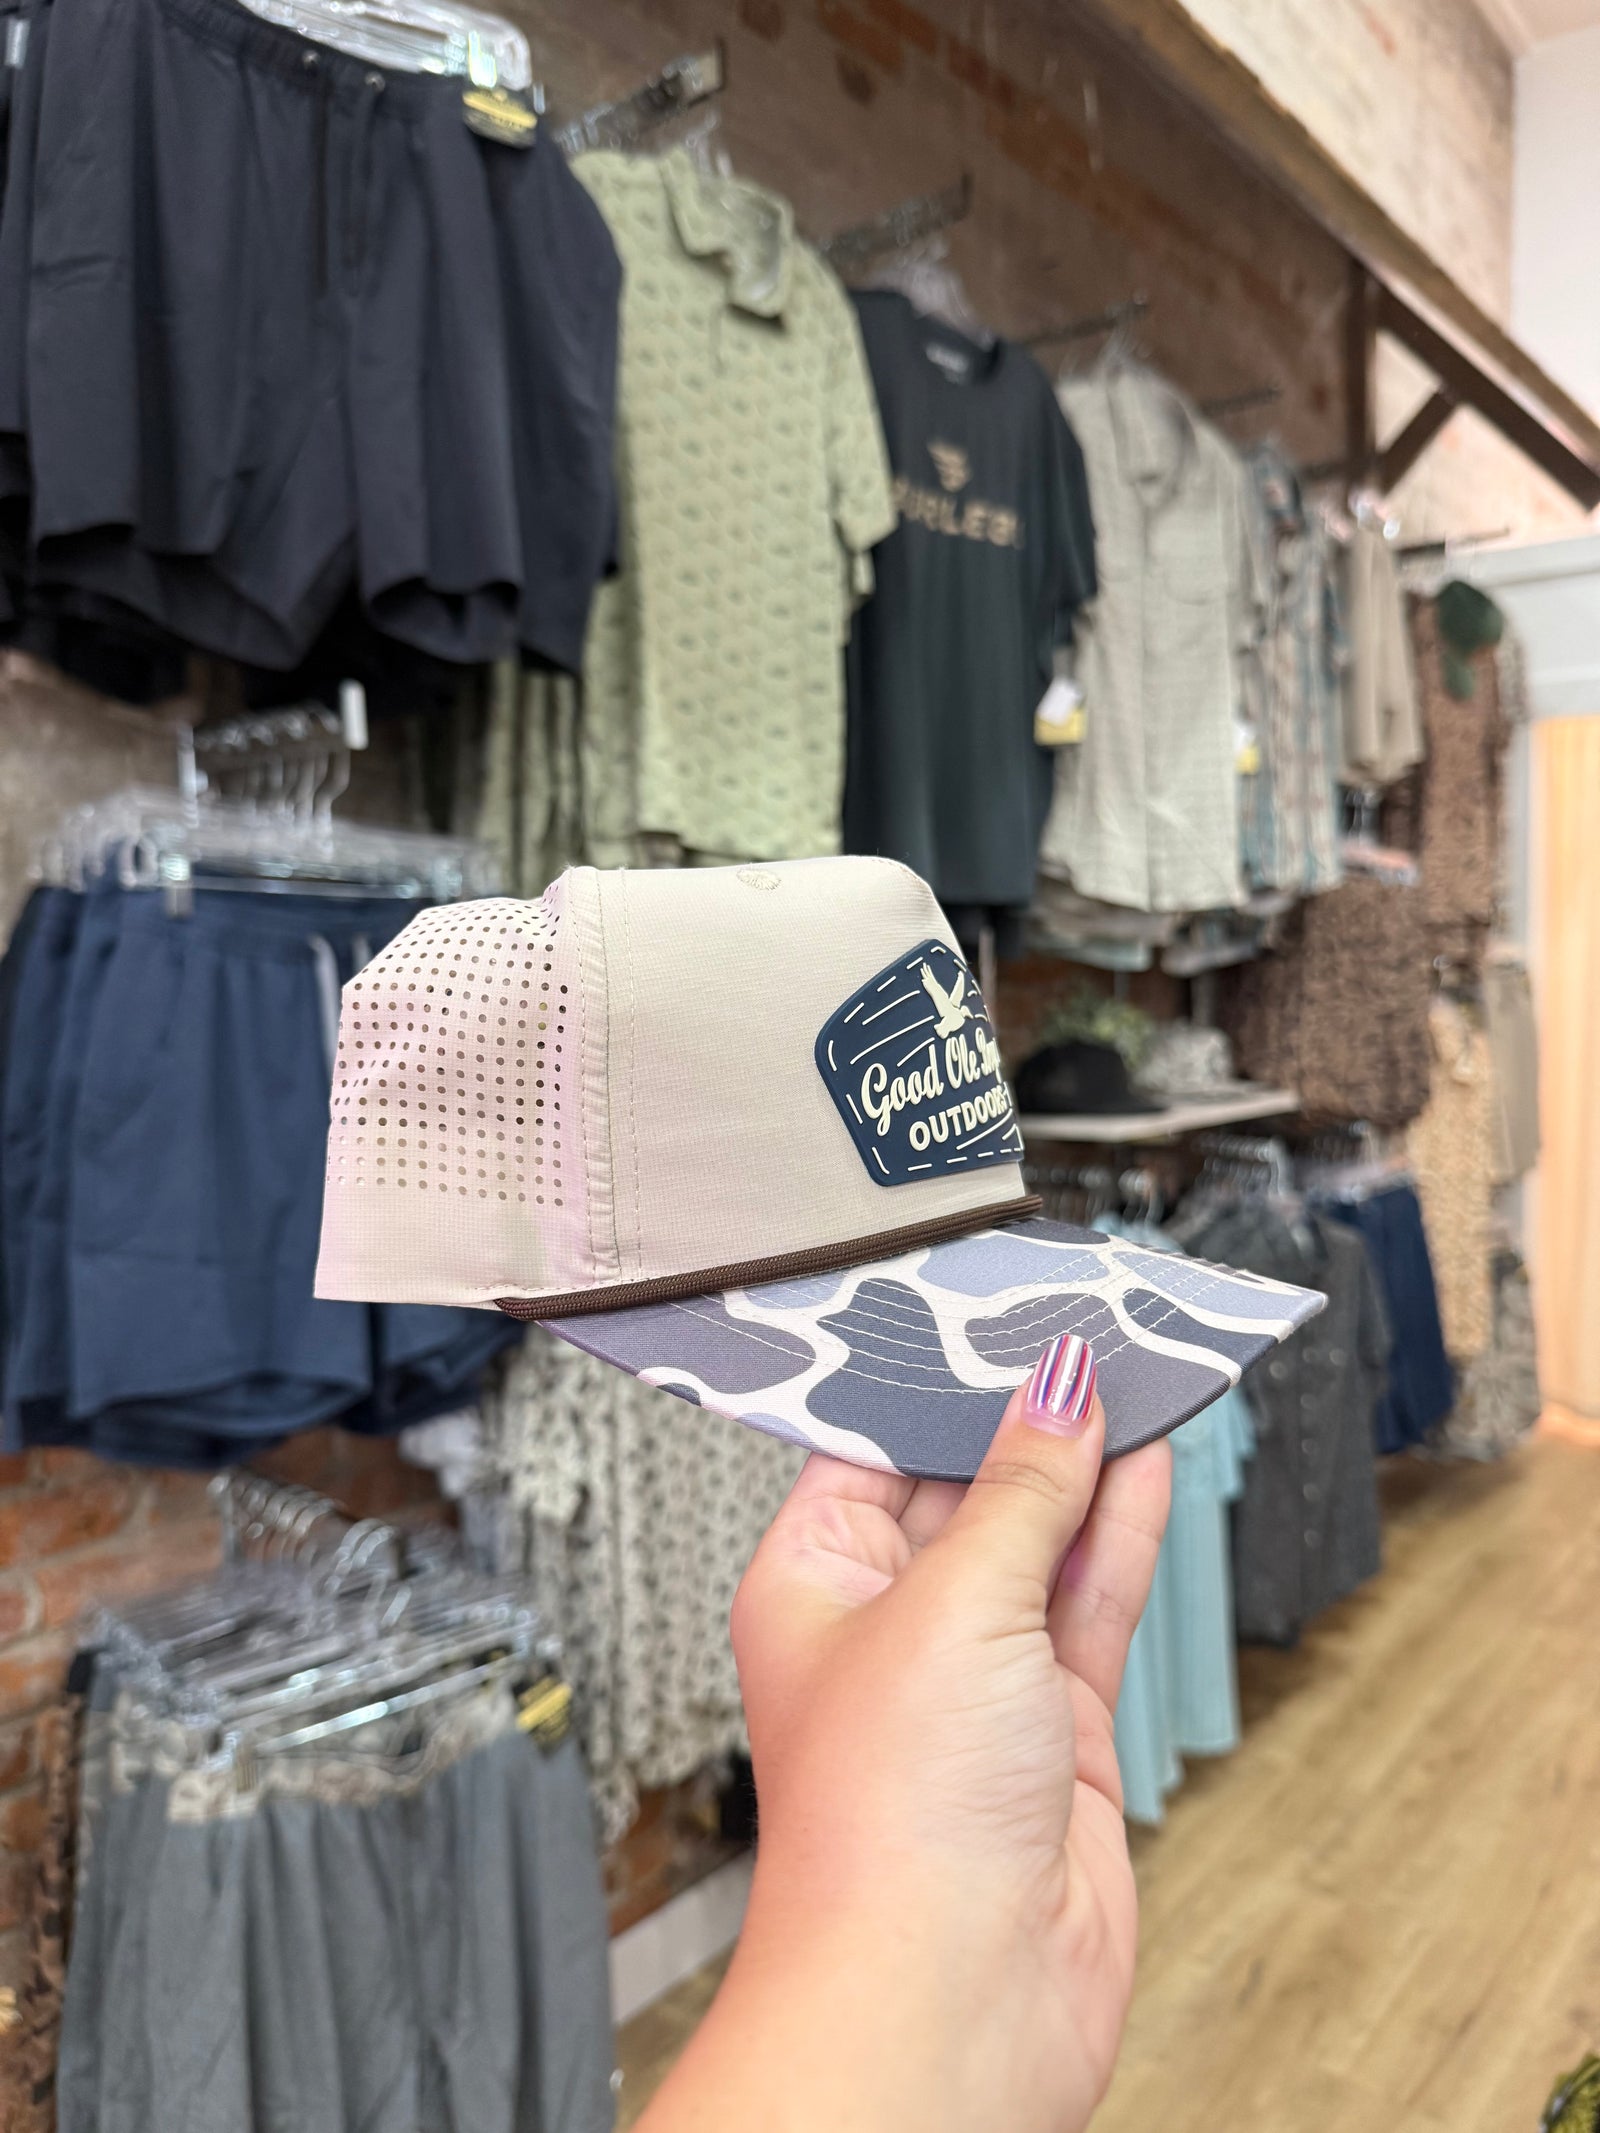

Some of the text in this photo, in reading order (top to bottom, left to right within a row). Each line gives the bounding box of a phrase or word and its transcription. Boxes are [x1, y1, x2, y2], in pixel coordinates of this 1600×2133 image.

[861, 1043, 945, 1137] Good
[945, 1033, 981, 1089] Ole
[909, 1084, 1008, 1152] OUTDOORS
